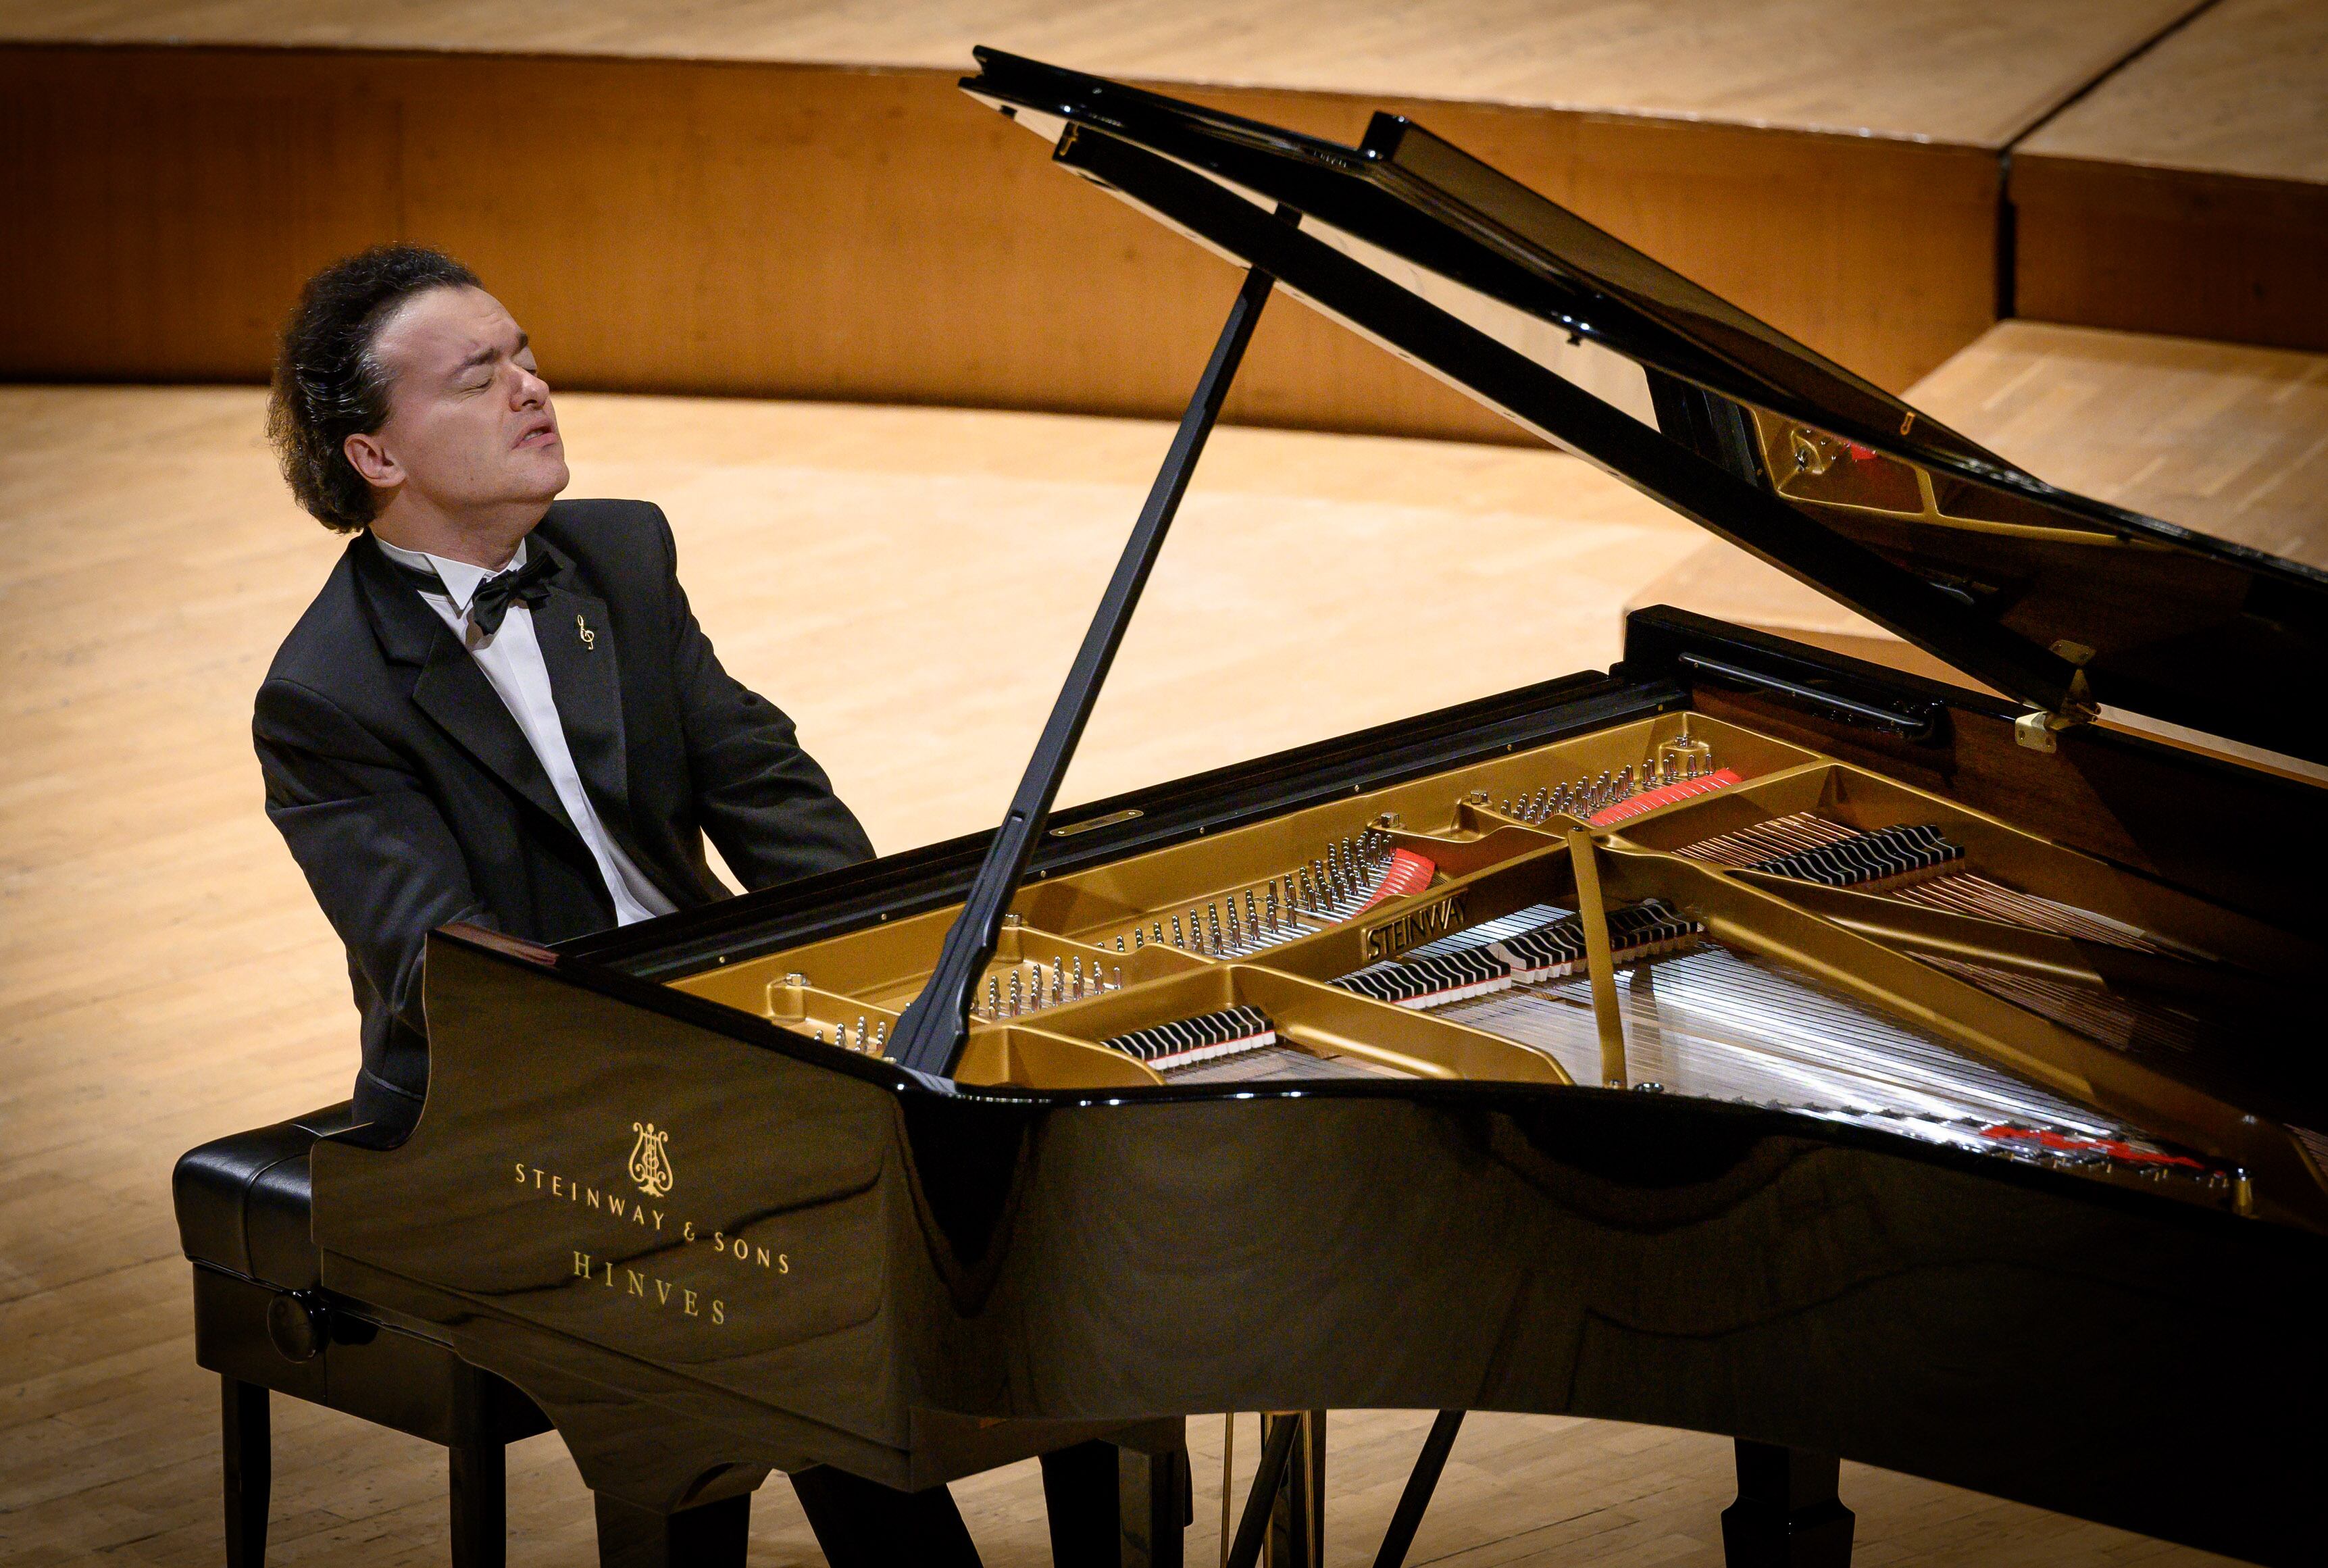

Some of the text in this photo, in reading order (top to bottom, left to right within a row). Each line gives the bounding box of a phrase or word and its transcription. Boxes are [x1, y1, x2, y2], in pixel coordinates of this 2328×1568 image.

[1368, 895, 1467, 959] STEINWAY
[515, 1163, 788, 1274] STEINWAY & SONS
[574, 1252, 725, 1325] HINVES
